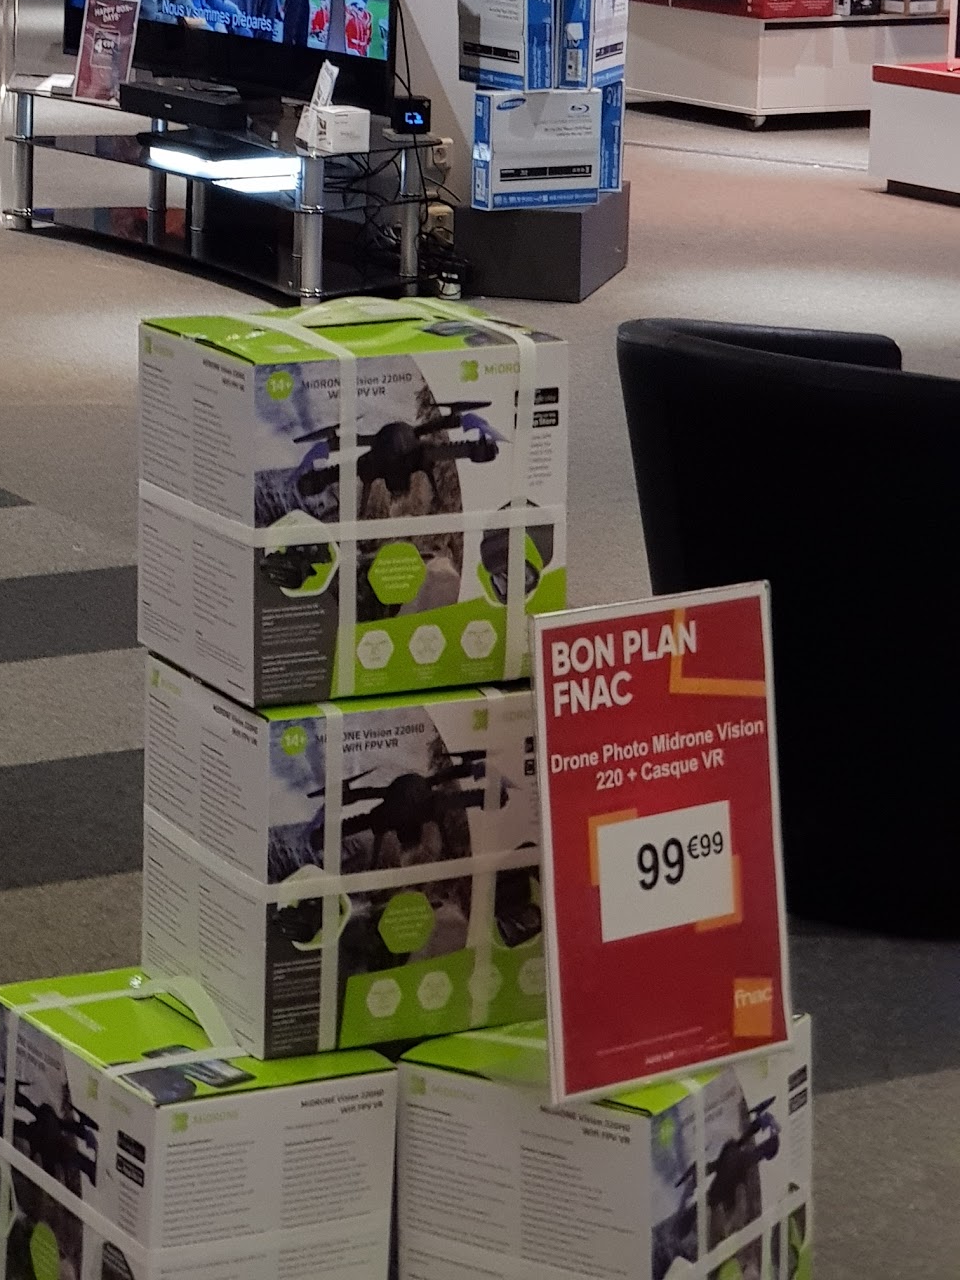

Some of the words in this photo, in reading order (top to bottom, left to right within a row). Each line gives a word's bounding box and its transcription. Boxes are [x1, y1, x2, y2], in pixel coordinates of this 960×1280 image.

[192, 8, 231, 25] sommes
[484, 361, 520, 375] MiDRO
[301, 377, 340, 390] MiDRON
[356, 374, 379, 386] ision
[381, 372, 413, 385] 220HD
[372, 386, 386, 397] VR
[551, 632, 616, 677] BON
[622, 620, 697, 665] PLAN
[553, 670, 634, 718] FNAC
[363, 727, 392, 740] Vision
[394, 723, 425, 737] 220HD
[364, 740, 384, 751] FPV
[385, 738, 399, 749] VR
[550, 751, 599, 774] Drone
[602, 740, 649, 764] Photo
[652, 729, 714, 753] Midrone
[716, 719, 765, 742] Vision
[596, 768, 623, 791] 220
[627, 770, 638, 783] +
[641, 757, 699, 782] Casque
[701, 748, 726, 770] VR
[637, 830, 724, 891] 99€99
[734, 986, 773, 1009] fnac
